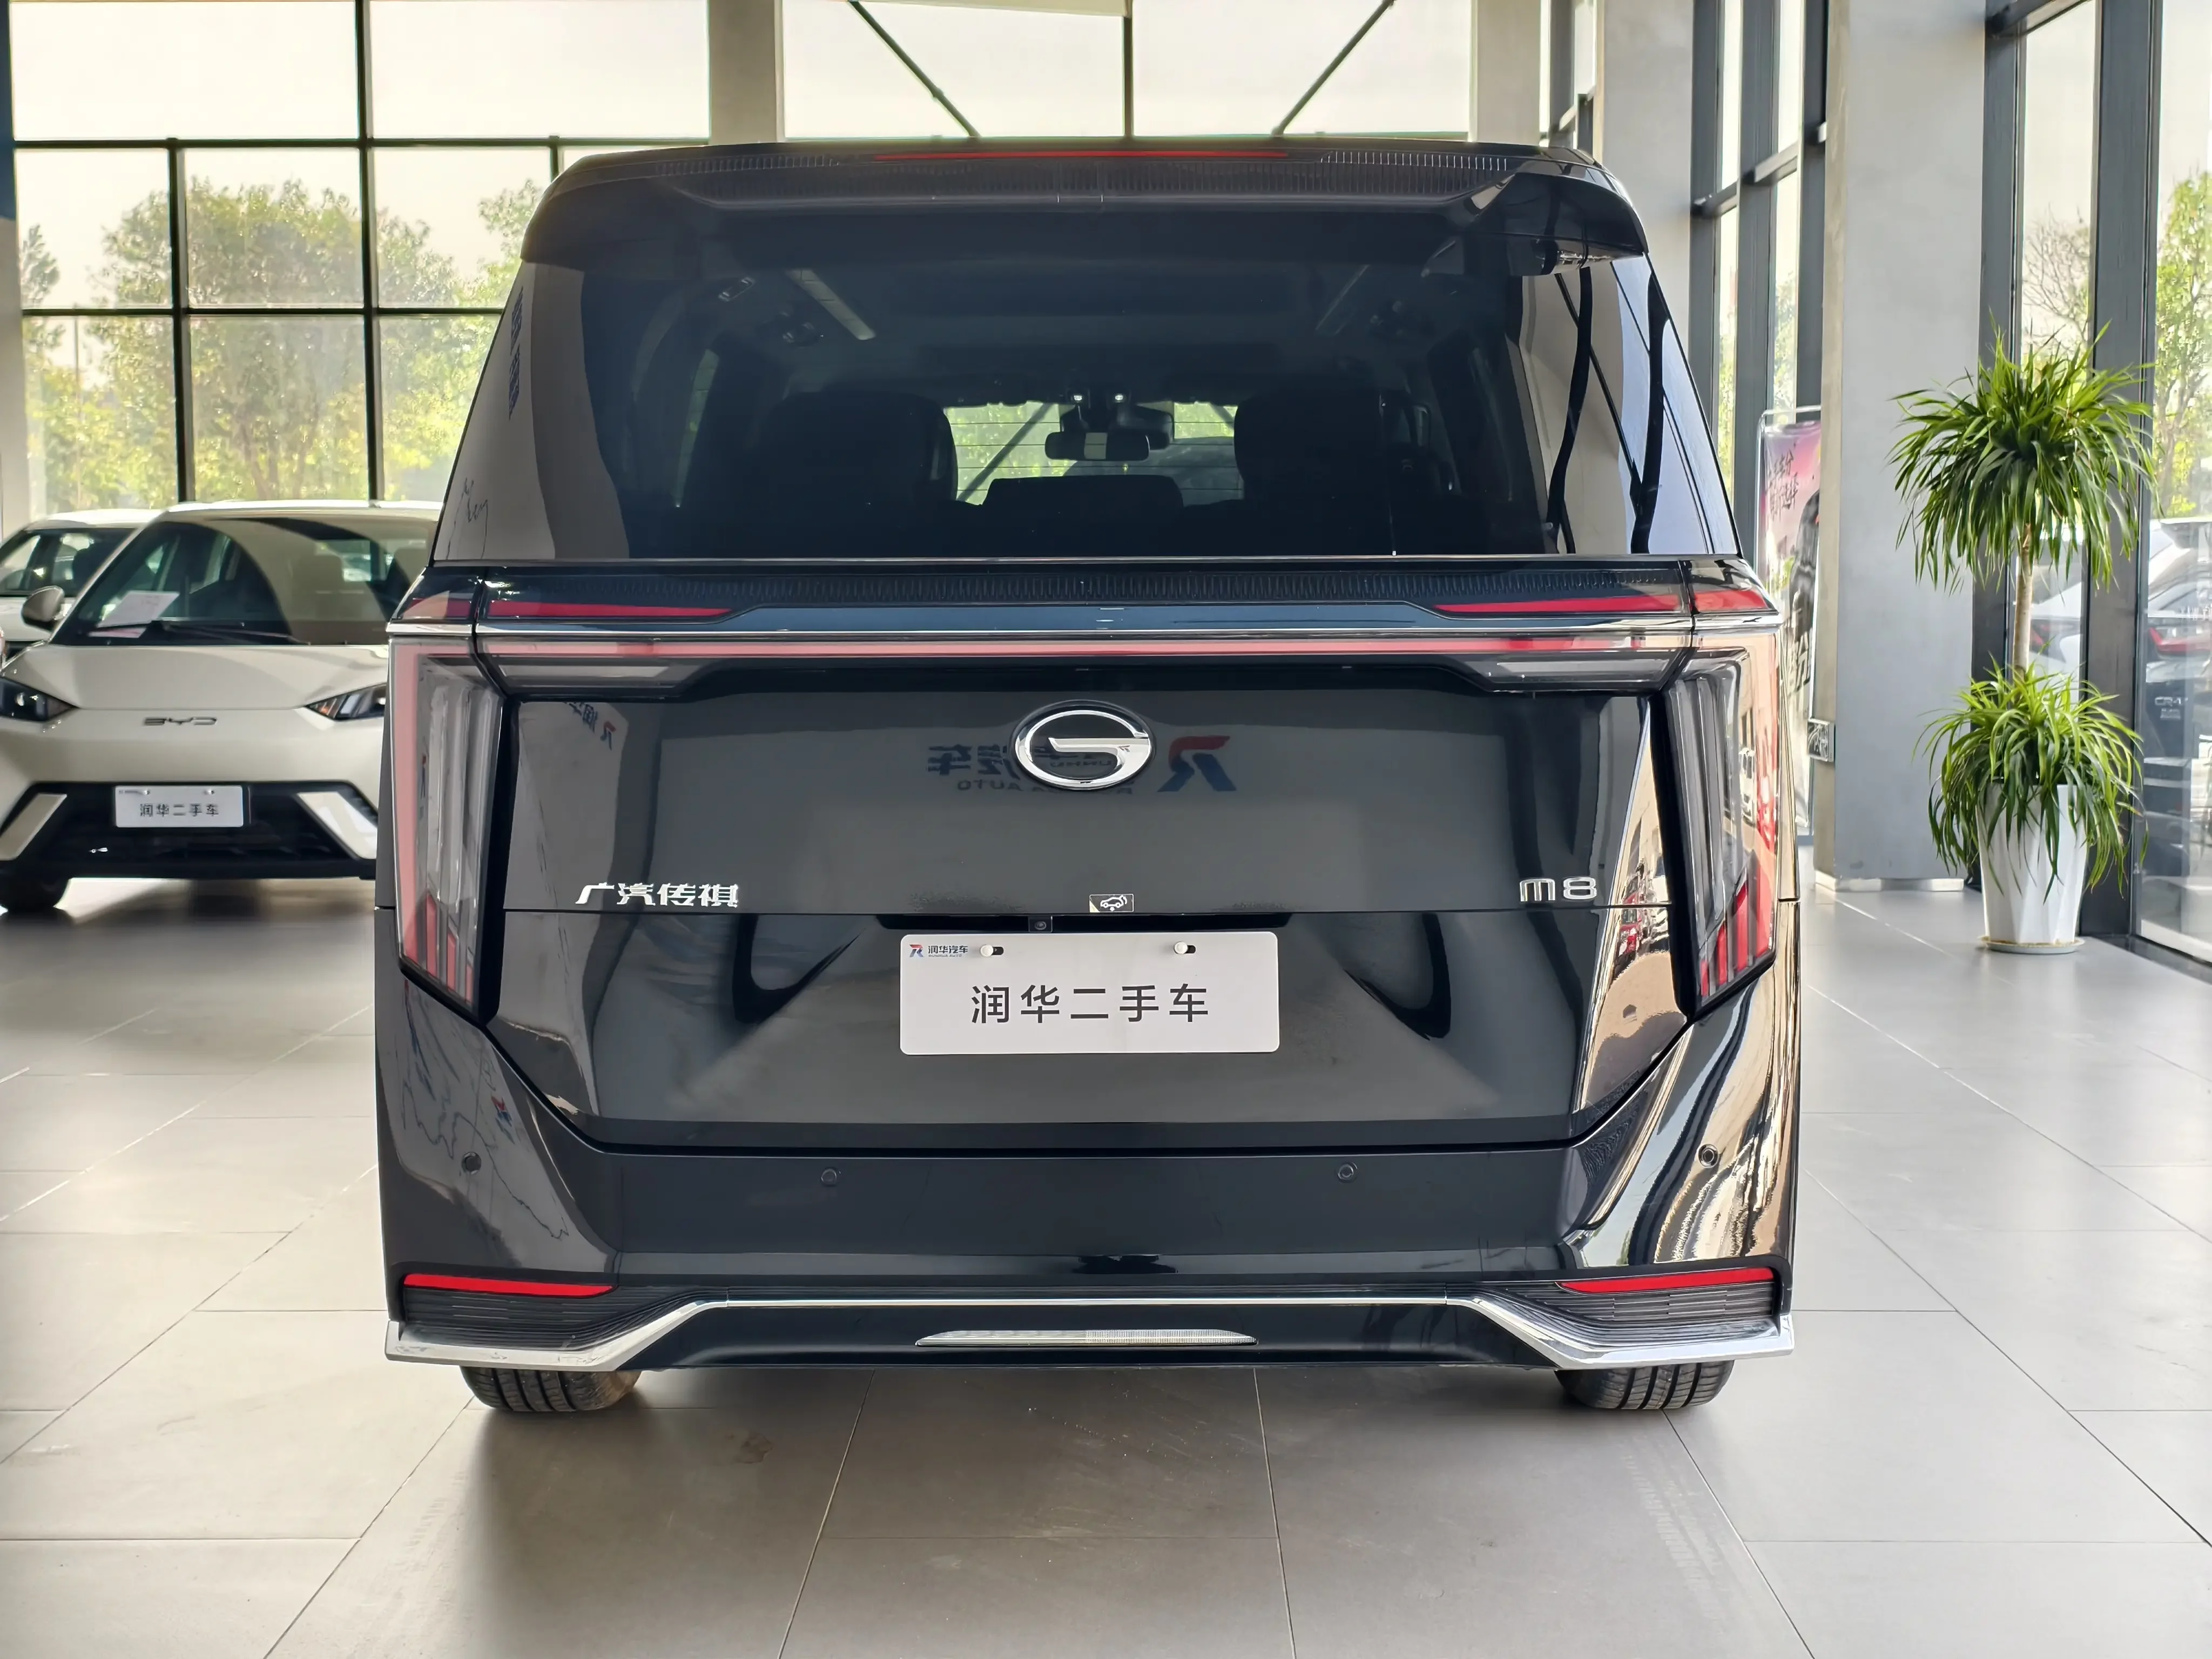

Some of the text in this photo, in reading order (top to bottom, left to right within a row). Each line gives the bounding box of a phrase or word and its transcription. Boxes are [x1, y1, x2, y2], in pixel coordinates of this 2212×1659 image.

[144, 717, 217, 725] BYD
[140, 804, 219, 817] 润华二手车
[575, 882, 738, 908] 广汽传祺
[1519, 876, 1597, 901] M8
[928, 945, 968, 954] 润华汽车
[971, 983, 1209, 1024] 润华二手车
